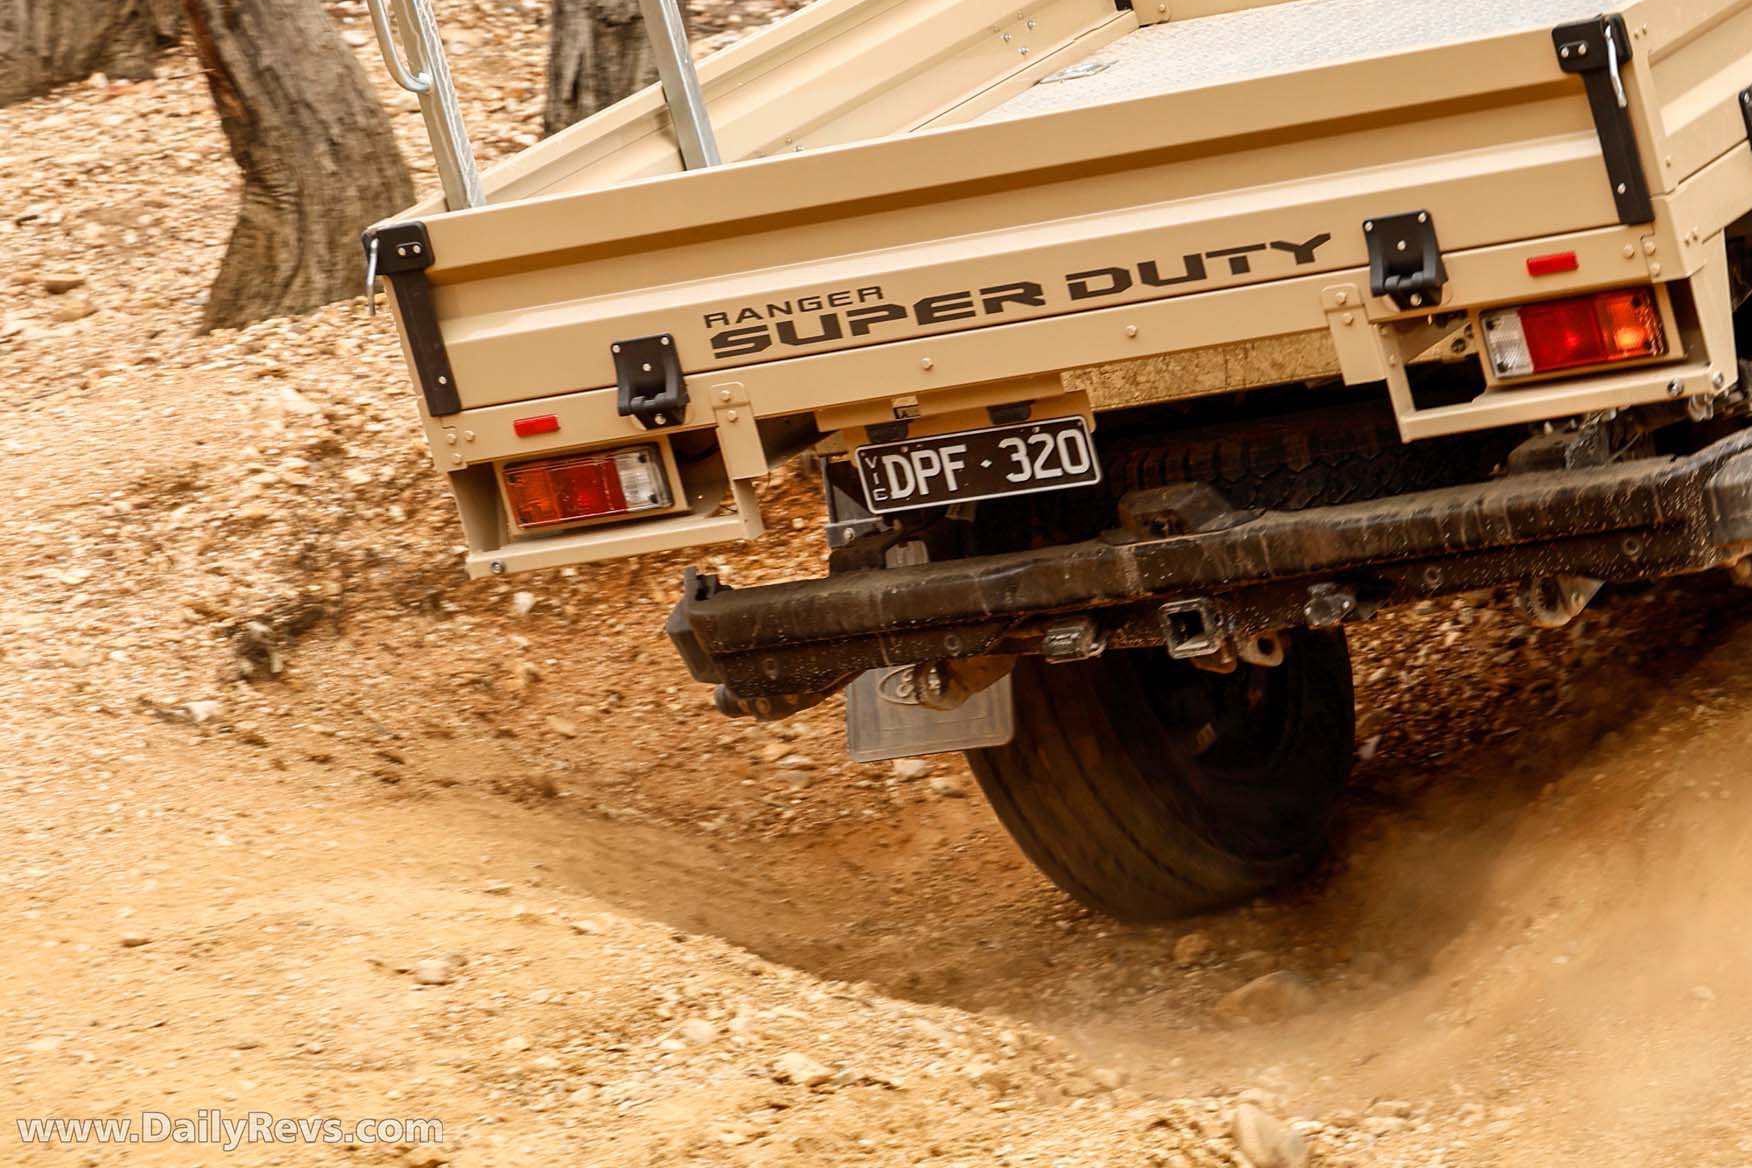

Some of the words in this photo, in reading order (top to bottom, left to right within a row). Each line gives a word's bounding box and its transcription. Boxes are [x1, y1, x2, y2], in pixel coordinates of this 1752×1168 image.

[703, 285, 884, 329] RANGER
[710, 281, 1046, 359] SUPER
[1065, 232, 1331, 301] DUTY
[881, 444, 967, 499] DPF
[998, 429, 1091, 482] 320
